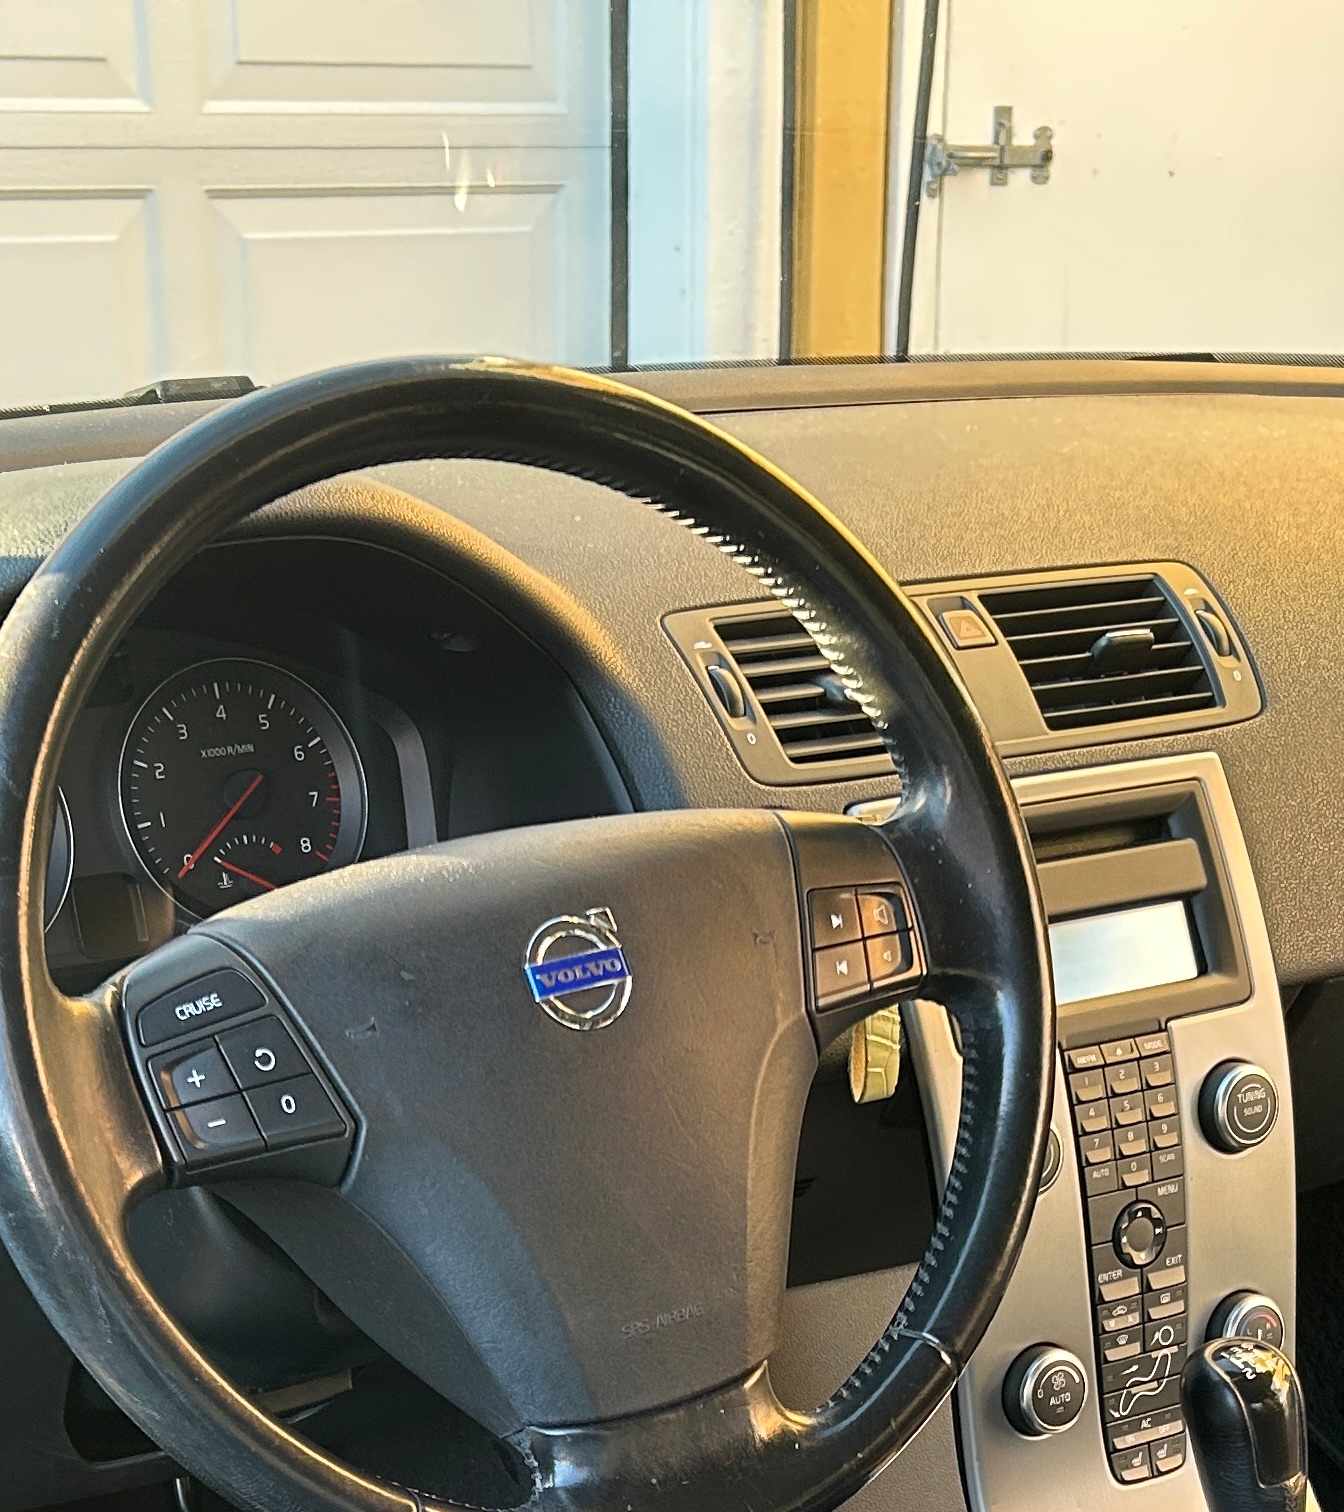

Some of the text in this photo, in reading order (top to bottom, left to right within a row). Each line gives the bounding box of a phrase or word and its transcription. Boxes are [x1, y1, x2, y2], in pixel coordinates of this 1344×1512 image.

[216, 705, 226, 720] 4
[258, 714, 270, 729] 5
[176, 724, 188, 740] 3
[200, 748, 226, 759] X1000
[294, 746, 305, 762] 6
[154, 763, 166, 779] 2
[308, 792, 319, 807] 7
[160, 812, 166, 828] 1
[300, 837, 312, 853] 8
[536, 958, 622, 988] VOLVO
[174, 992, 223, 1021] CRUISE
[1143, 1040, 1164, 1050] MODE
[1154, 1062, 1160, 1072] 3
[1084, 1076, 1089, 1086] 1
[1118, 1070, 1125, 1080] 2
[1157, 1092, 1164, 1102] 6
[1237, 1087, 1266, 1104] TUNING
[280, 1094, 296, 1114] 0
[1124, 1100, 1130, 1110] 5
[1243, 1104, 1263, 1116] SOUND
[1088, 1107, 1096, 1117] 4
[1161, 1124, 1168, 1134] 9
[1128, 1130, 1134, 1141] 8
[1094, 1138, 1100, 1148] 7
[1158, 1153, 1176, 1163] SCAN
[1092, 1168, 1110, 1178] AUTO
[1130, 1162, 1137, 1172] 0
[1157, 1183, 1179, 1196] MENU
[1166, 1254, 1182, 1266] EXIT
[1098, 1269, 1123, 1284] ENTER
[656, 1302, 705, 1330] AIRBAG
[1037, 1388, 1044, 1399] 0
[1049, 1392, 1071, 1406] AUTO
[1140, 1417, 1152, 1430] AC
